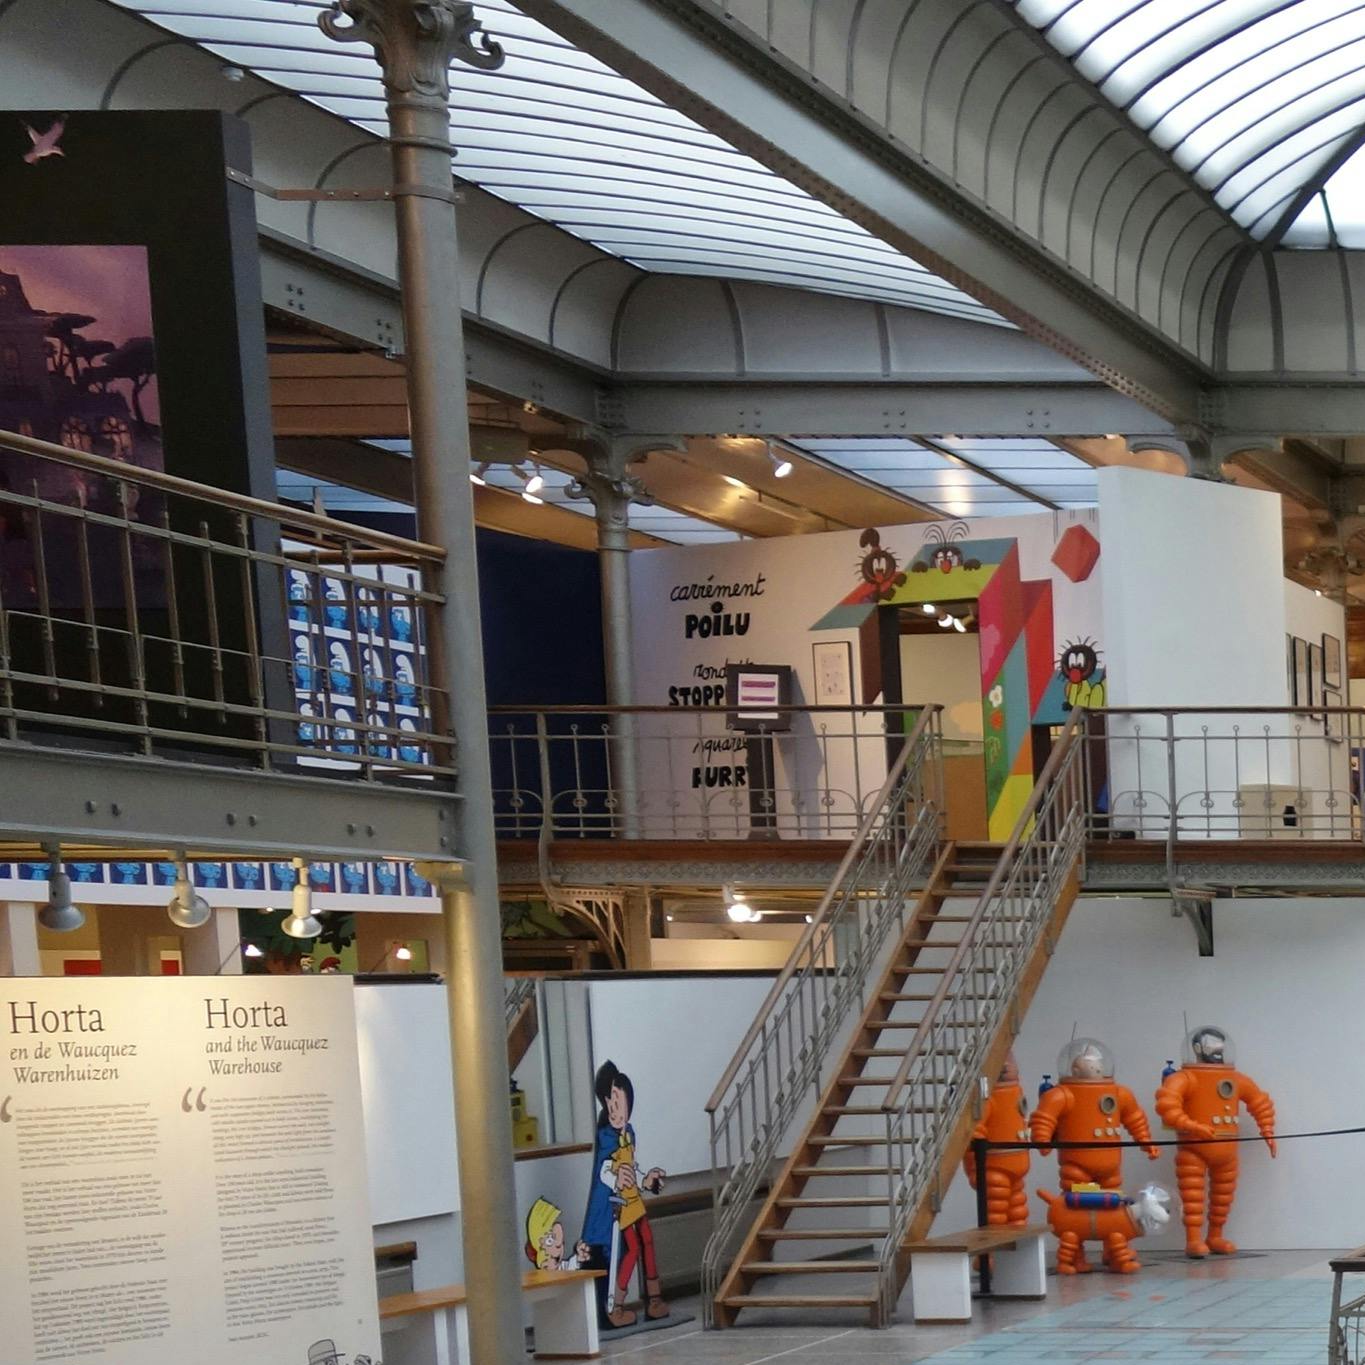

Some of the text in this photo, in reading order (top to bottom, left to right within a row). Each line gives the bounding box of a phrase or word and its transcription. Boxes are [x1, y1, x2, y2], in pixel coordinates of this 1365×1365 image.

[670, 572, 766, 601] carrément
[692, 765, 749, 788] FURR
[8, 1001, 105, 1034] Horta
[204, 998, 288, 1029] Horta
[10, 1041, 138, 1063] en de Waucquez
[206, 1035, 329, 1055] and the Waucquez
[14, 1063, 120, 1084] Warenhuizen
[209, 1057, 283, 1075] Warehouse
